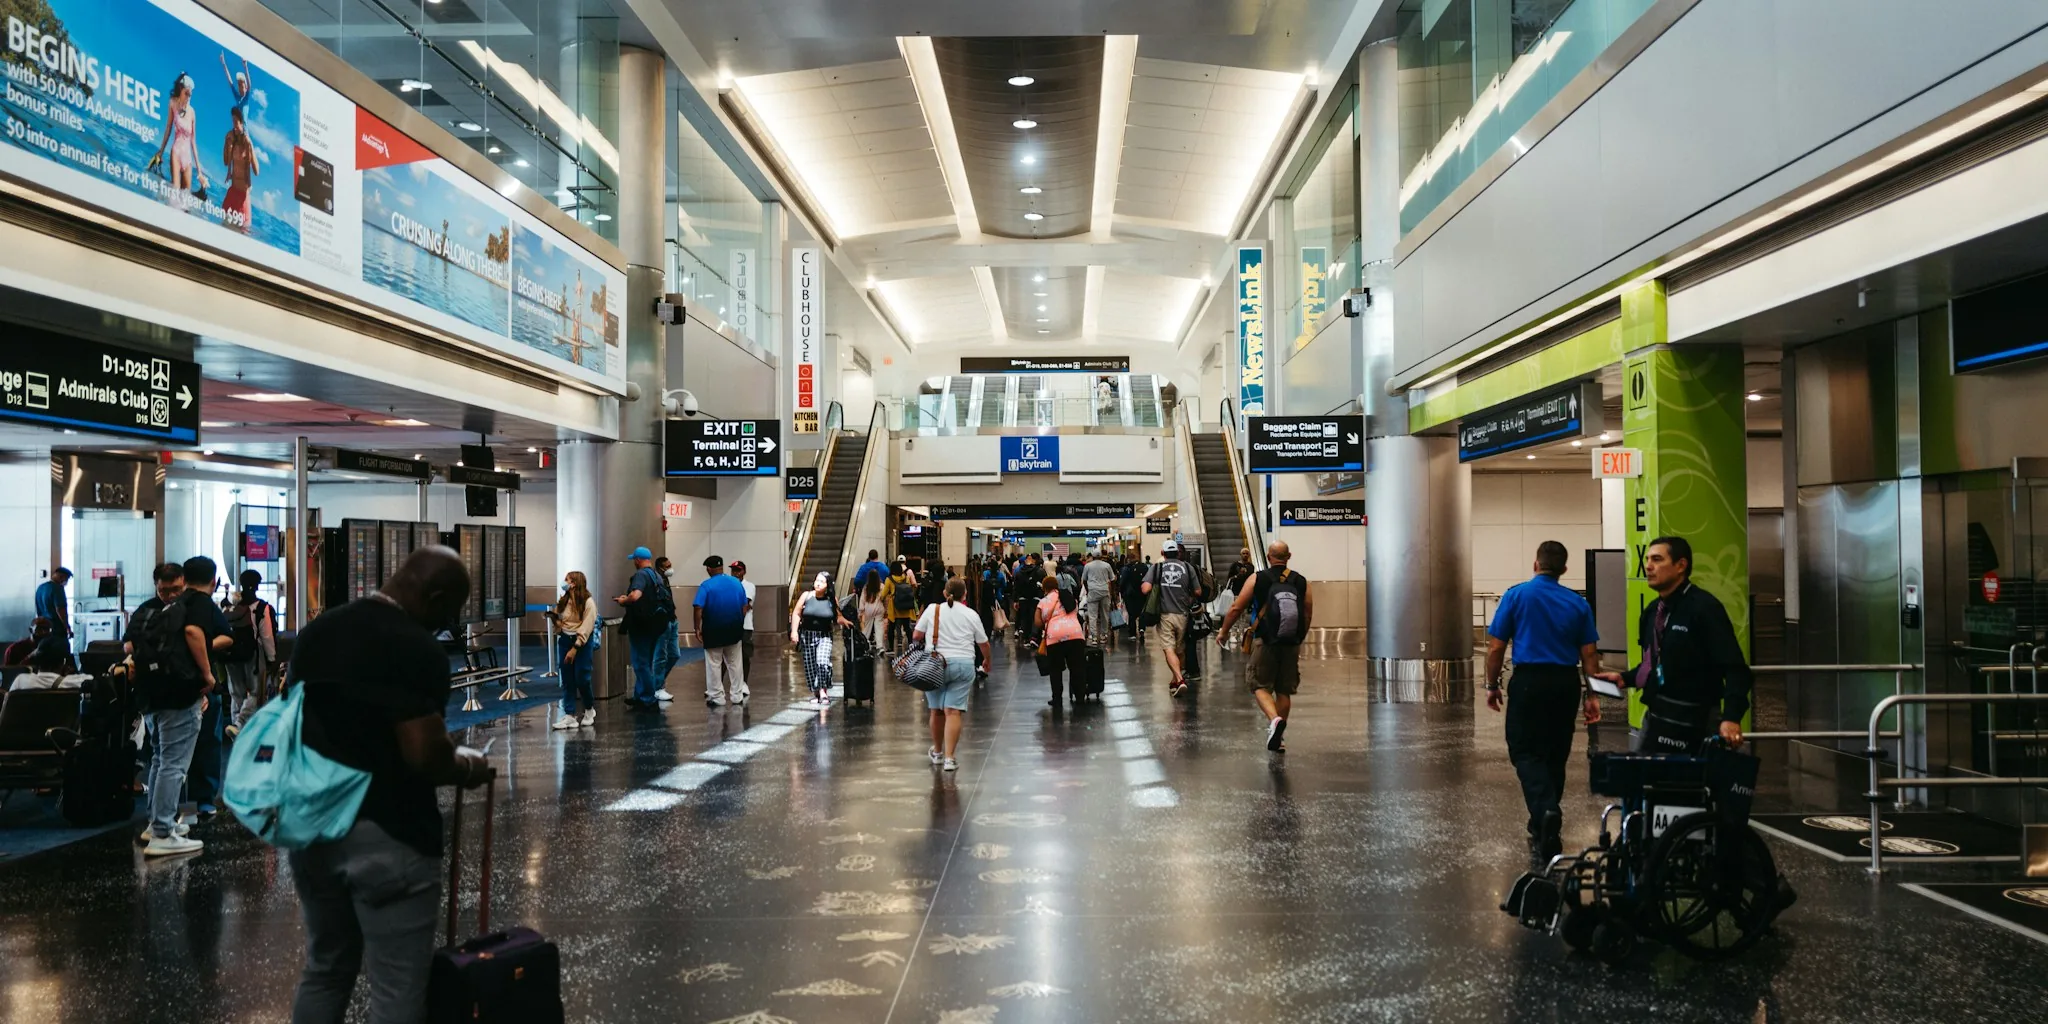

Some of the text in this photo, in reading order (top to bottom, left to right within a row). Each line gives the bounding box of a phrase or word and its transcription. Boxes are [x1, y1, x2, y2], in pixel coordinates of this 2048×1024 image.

[8, 15, 161, 120] BEGINS HERE
[7, 62, 37, 88] with
[40, 74, 84, 108] 50,000
[7, 82, 85, 132] bonus miles.
[6, 115, 24, 139] $0
[27, 124, 58, 152] intro
[60, 142, 101, 170] annual
[101, 157, 121, 178] fee
[123, 165, 140, 185] for
[140, 173, 159, 193] the
[160, 180, 181, 200] first
[181, 191, 204, 212] year,
[205, 199, 226, 220] then
[391, 212, 441, 255] CRUISING
[443, 237, 475, 271] ALONG
[518, 275, 561, 312] BEGINS HERE
[801, 252, 810, 362] CLUBHOUSE
[1240, 262, 1263, 386] NewsLink
[102, 354, 149, 381] D1-D25
[58, 377, 149, 410] Admirals Club
[800, 368, 811, 406] one
[7, 394, 22, 406] D12
[136, 413, 148, 424] D15
[794, 412, 818, 421] KITCHEN
[703, 422, 739, 436] EXIT
[794, 423, 818, 432] & BAR
[1263, 422, 1321, 432] Baggage Claim
[692, 440, 739, 451] Terminal
[1026, 444, 1035, 458] 2
[1254, 442, 1322, 452] Ground Transport
[359, 456, 378, 469] FLIGHT
[694, 457, 739, 468] F, G, H, J
[1019, 459, 1052, 470] skytrain
[1602, 453, 1631, 474] EXIT
[789, 476, 814, 487] D25
[670, 504, 688, 516] EXIT
[1658, 735, 1688, 750] envoy
[1655, 813, 1667, 830] AA
